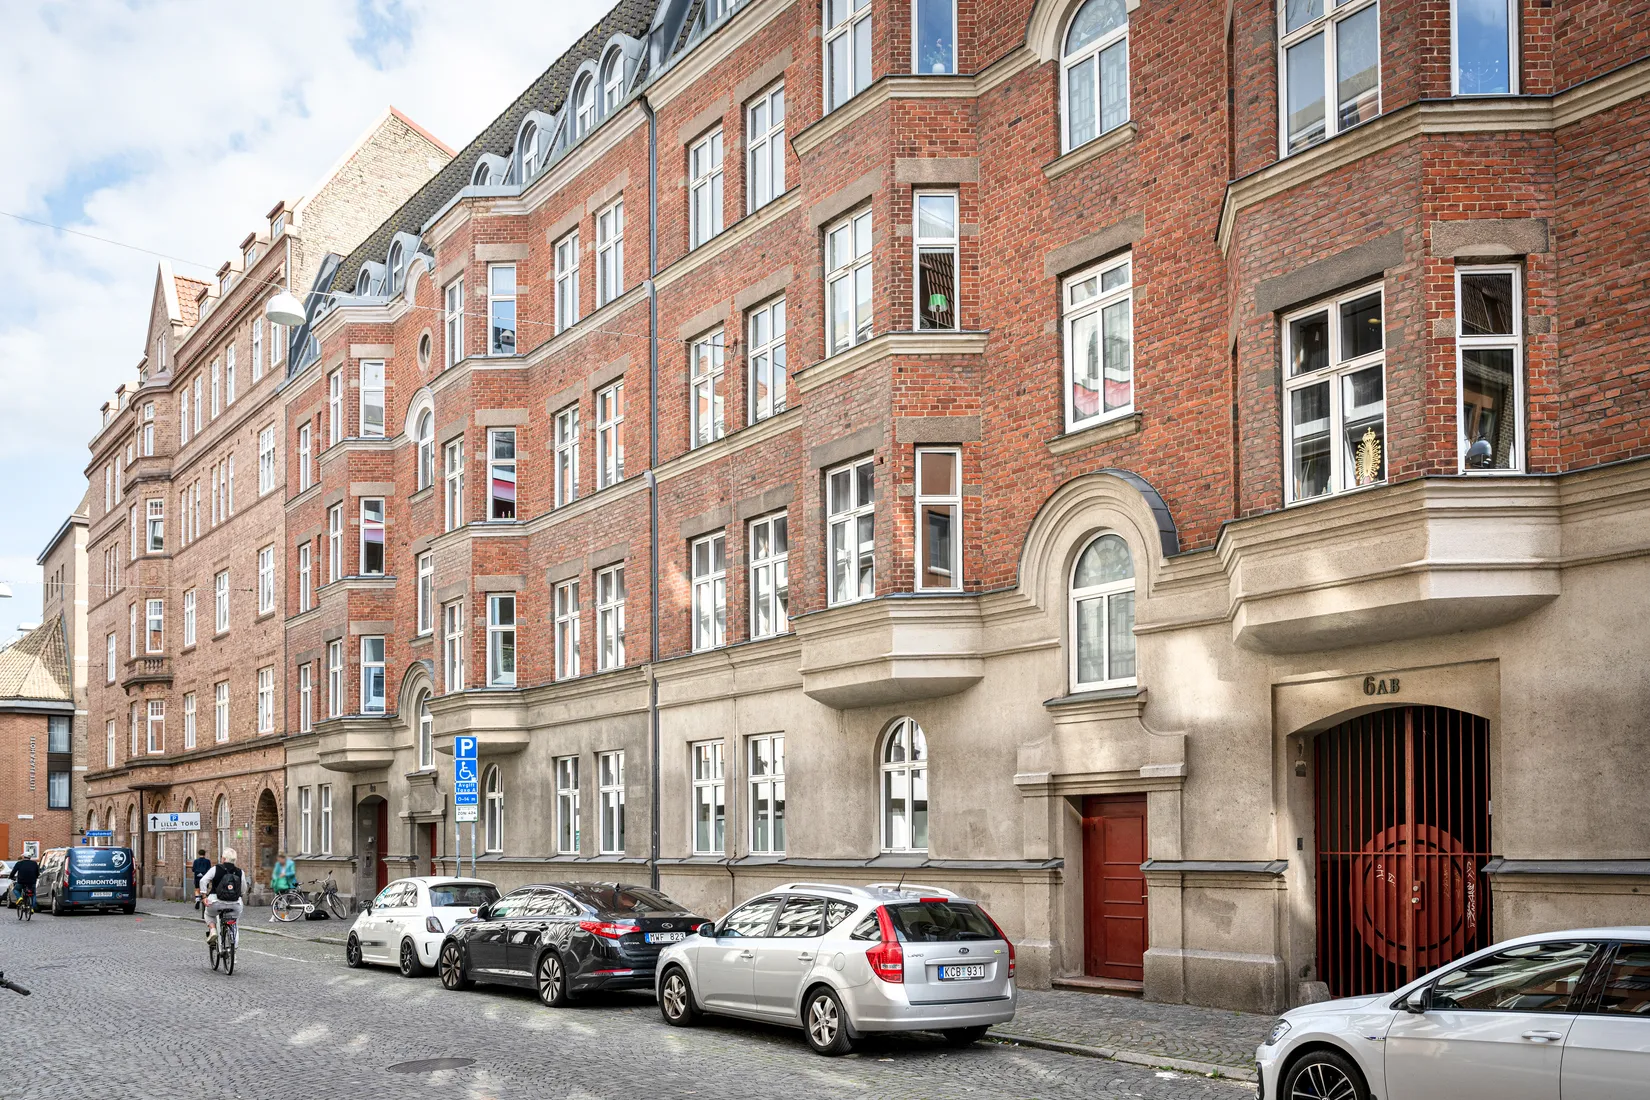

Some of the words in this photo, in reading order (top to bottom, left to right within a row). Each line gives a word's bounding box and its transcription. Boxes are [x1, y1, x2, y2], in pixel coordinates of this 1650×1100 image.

[1363, 675, 1400, 696] 6AB
[461, 738, 474, 756] P
[650, 932, 665, 942] MWF
[670, 932, 685, 941] 823
[944, 966, 961, 977] KCB
[967, 966, 983, 976] 931
